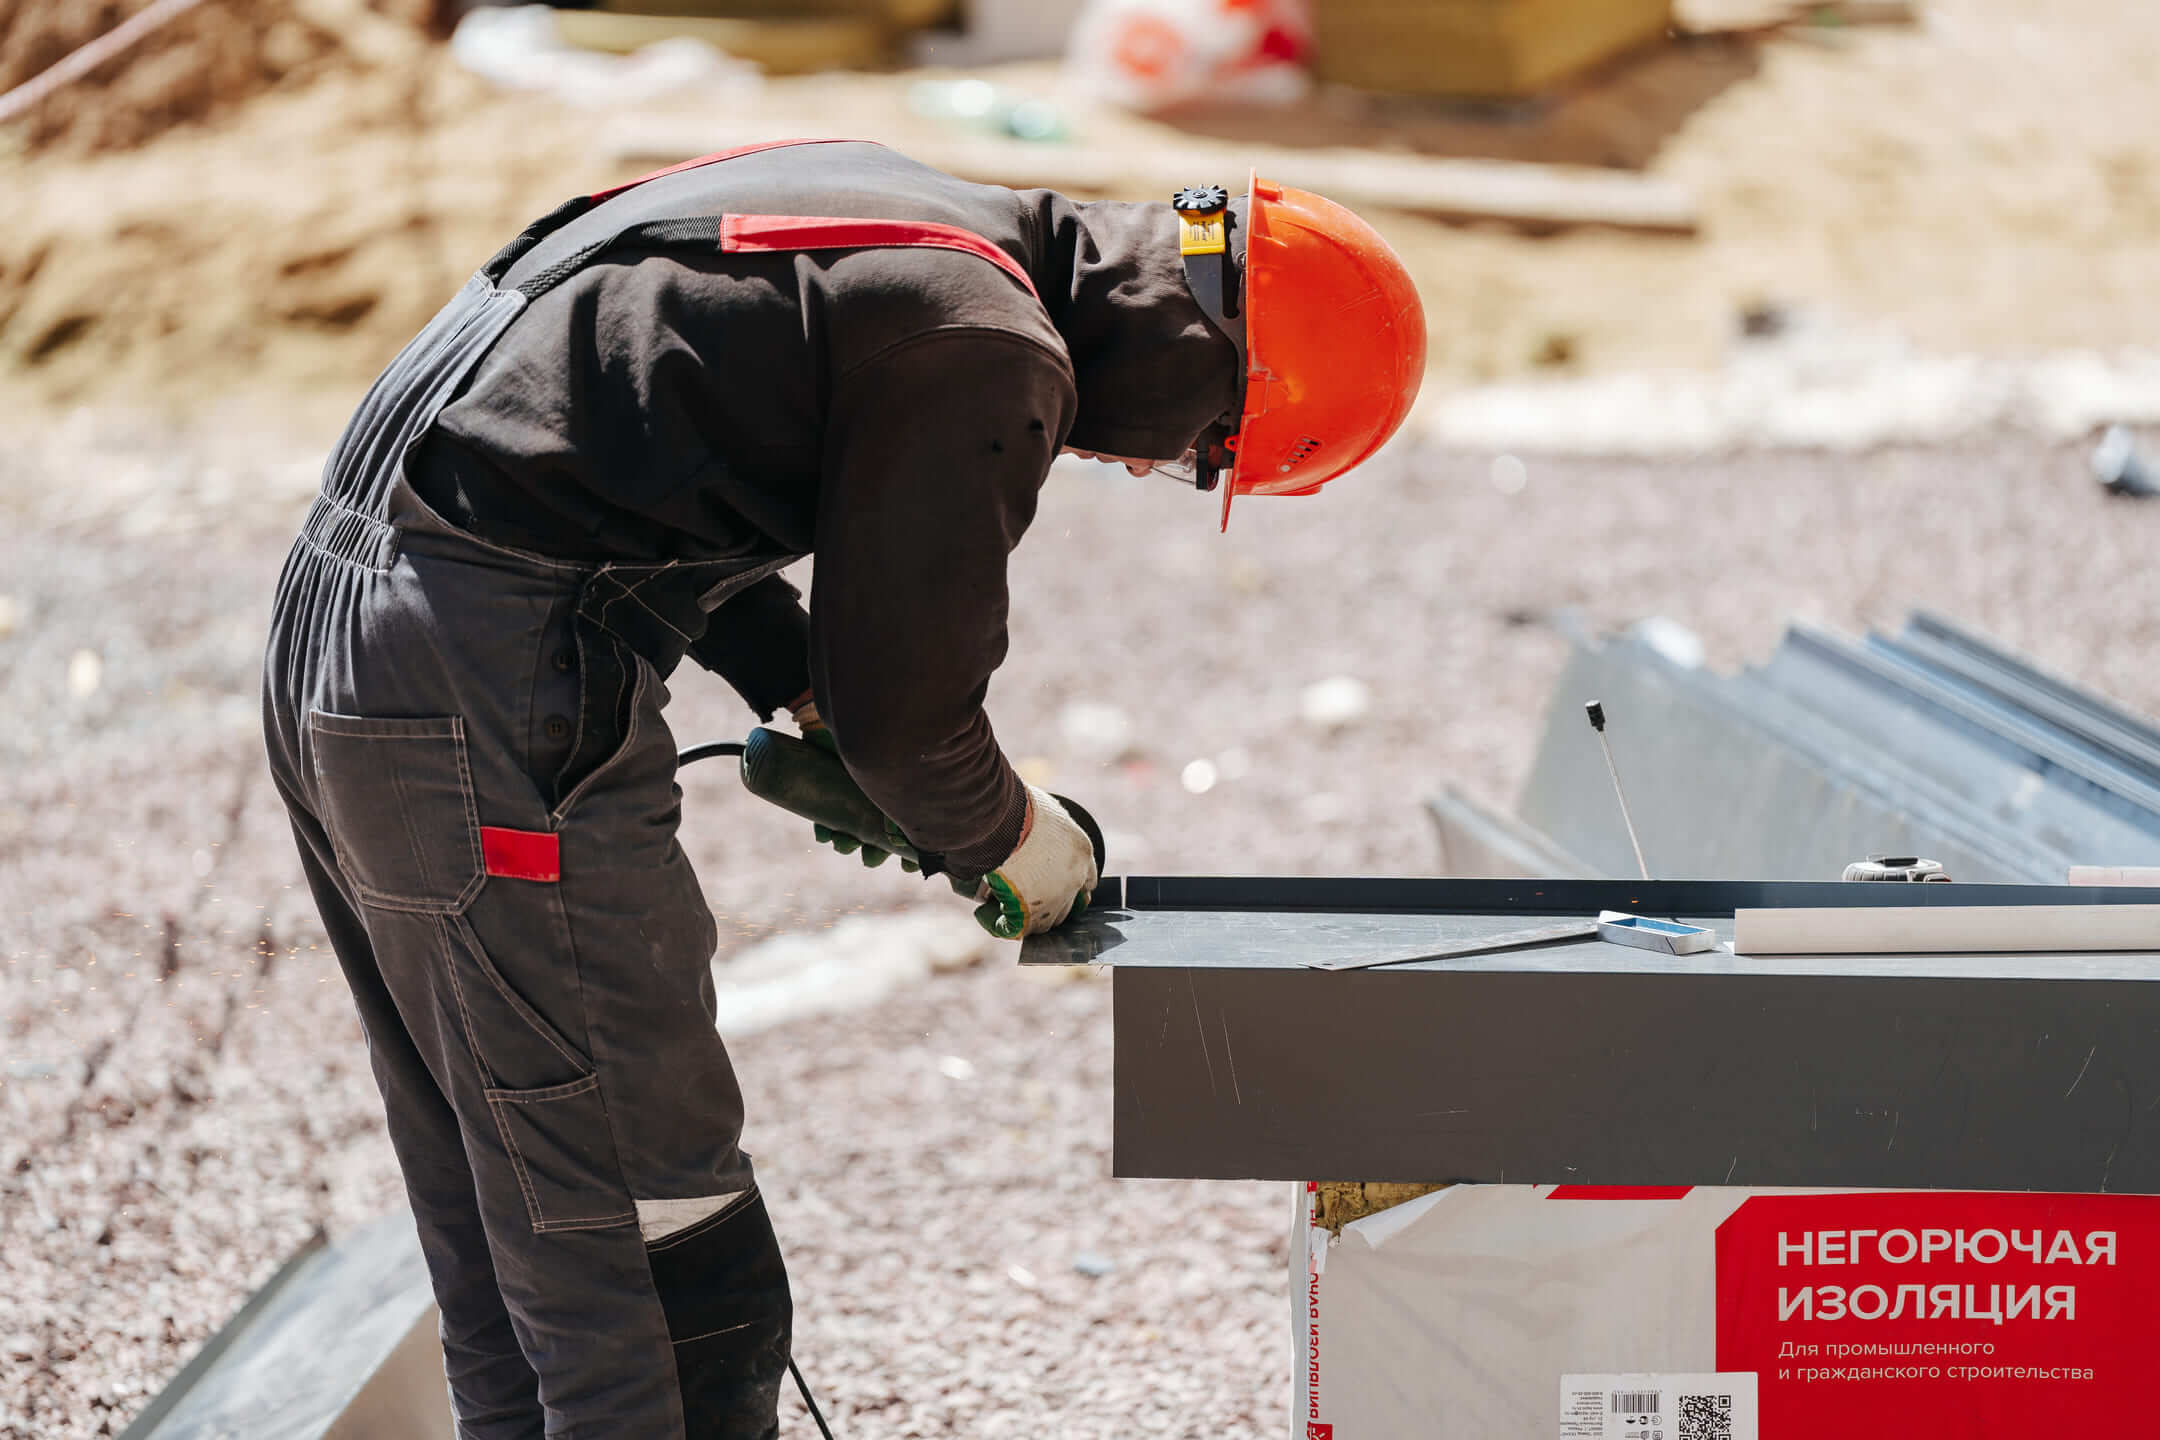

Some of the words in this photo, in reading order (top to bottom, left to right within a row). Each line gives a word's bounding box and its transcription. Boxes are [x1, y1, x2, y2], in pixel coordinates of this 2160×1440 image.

[1778, 1228, 2117, 1267] НЕГОРЮЧАЯ
[1778, 1284, 2076, 1326] ИЗОЛЯЦИЯ
[1778, 1341, 1819, 1359] Для
[1826, 1341, 1995, 1359] промышленного
[1779, 1369, 1790, 1380] и
[1797, 1366, 1940, 1382] гражданского
[1947, 1366, 2094, 1382] строительства
